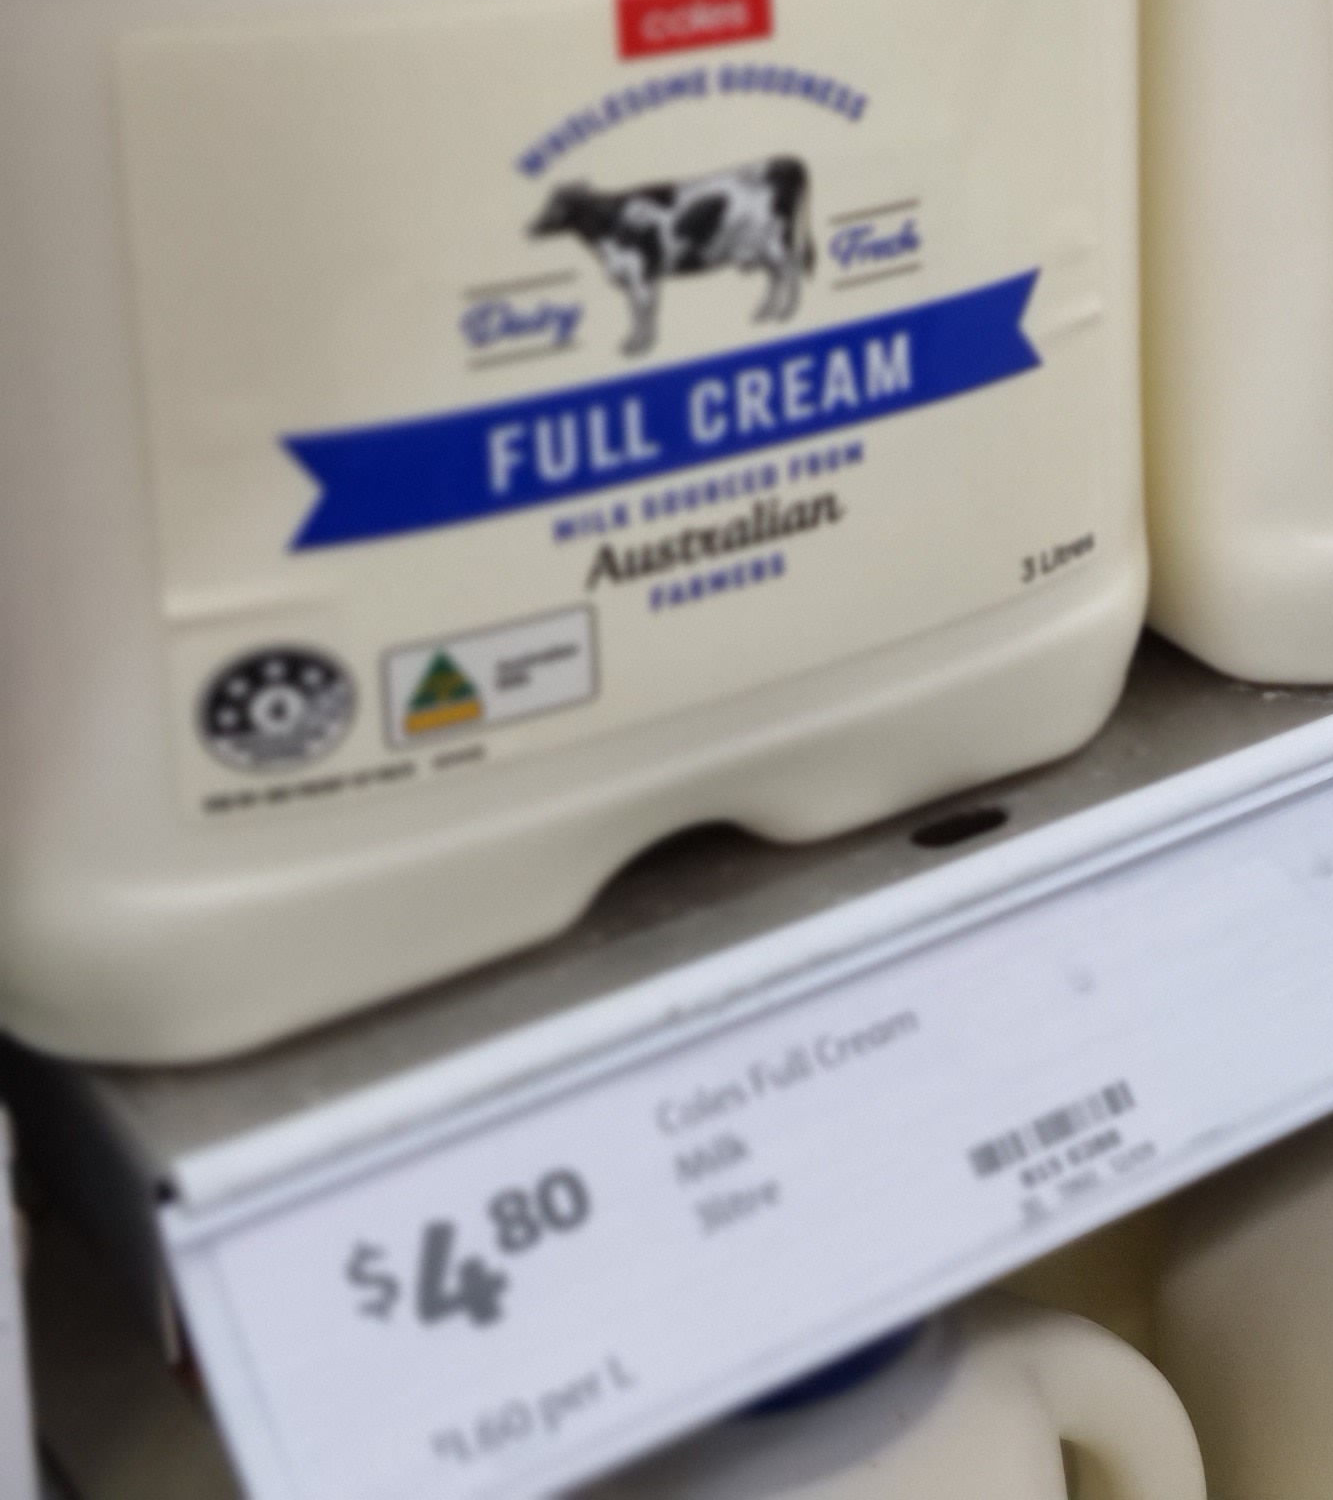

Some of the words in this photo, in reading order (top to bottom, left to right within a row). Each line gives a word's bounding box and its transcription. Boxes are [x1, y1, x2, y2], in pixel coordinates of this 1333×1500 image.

[460, 300, 582, 348] Dairy
[487, 395, 660, 495] FULL
[686, 332, 913, 446] CREAM
[585, 491, 846, 592] Australian
